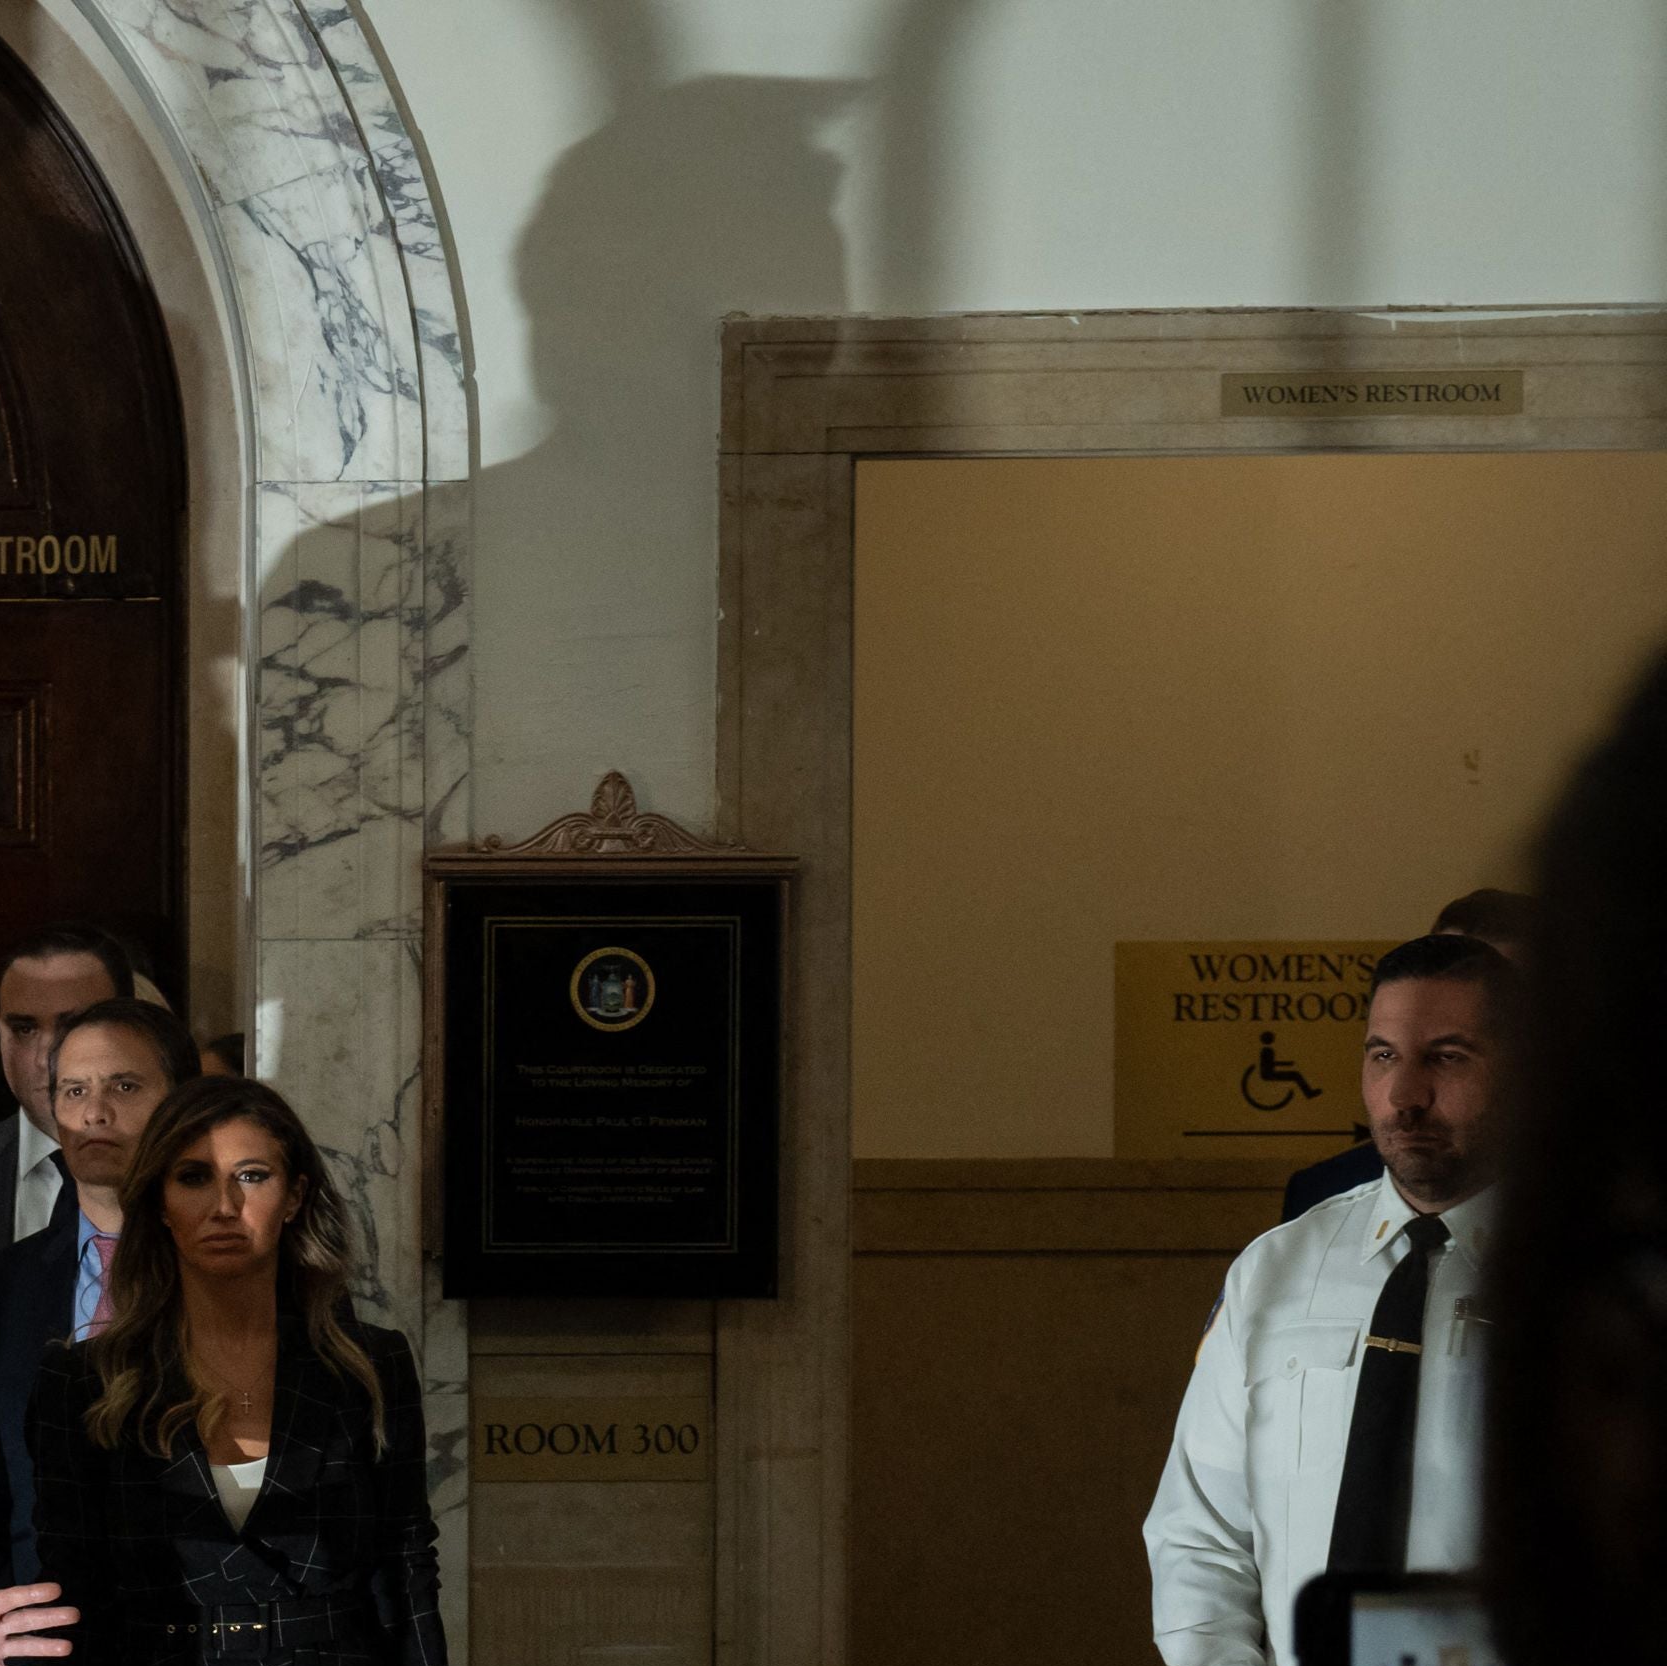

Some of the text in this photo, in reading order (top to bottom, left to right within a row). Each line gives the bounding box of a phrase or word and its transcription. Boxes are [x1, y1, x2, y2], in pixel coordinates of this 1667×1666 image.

[1242, 383, 1502, 404] WOMEN'S RESTROOM
[1190, 953, 1374, 982] WOMEN'S
[483, 1423, 700, 1455] ROOM 300
